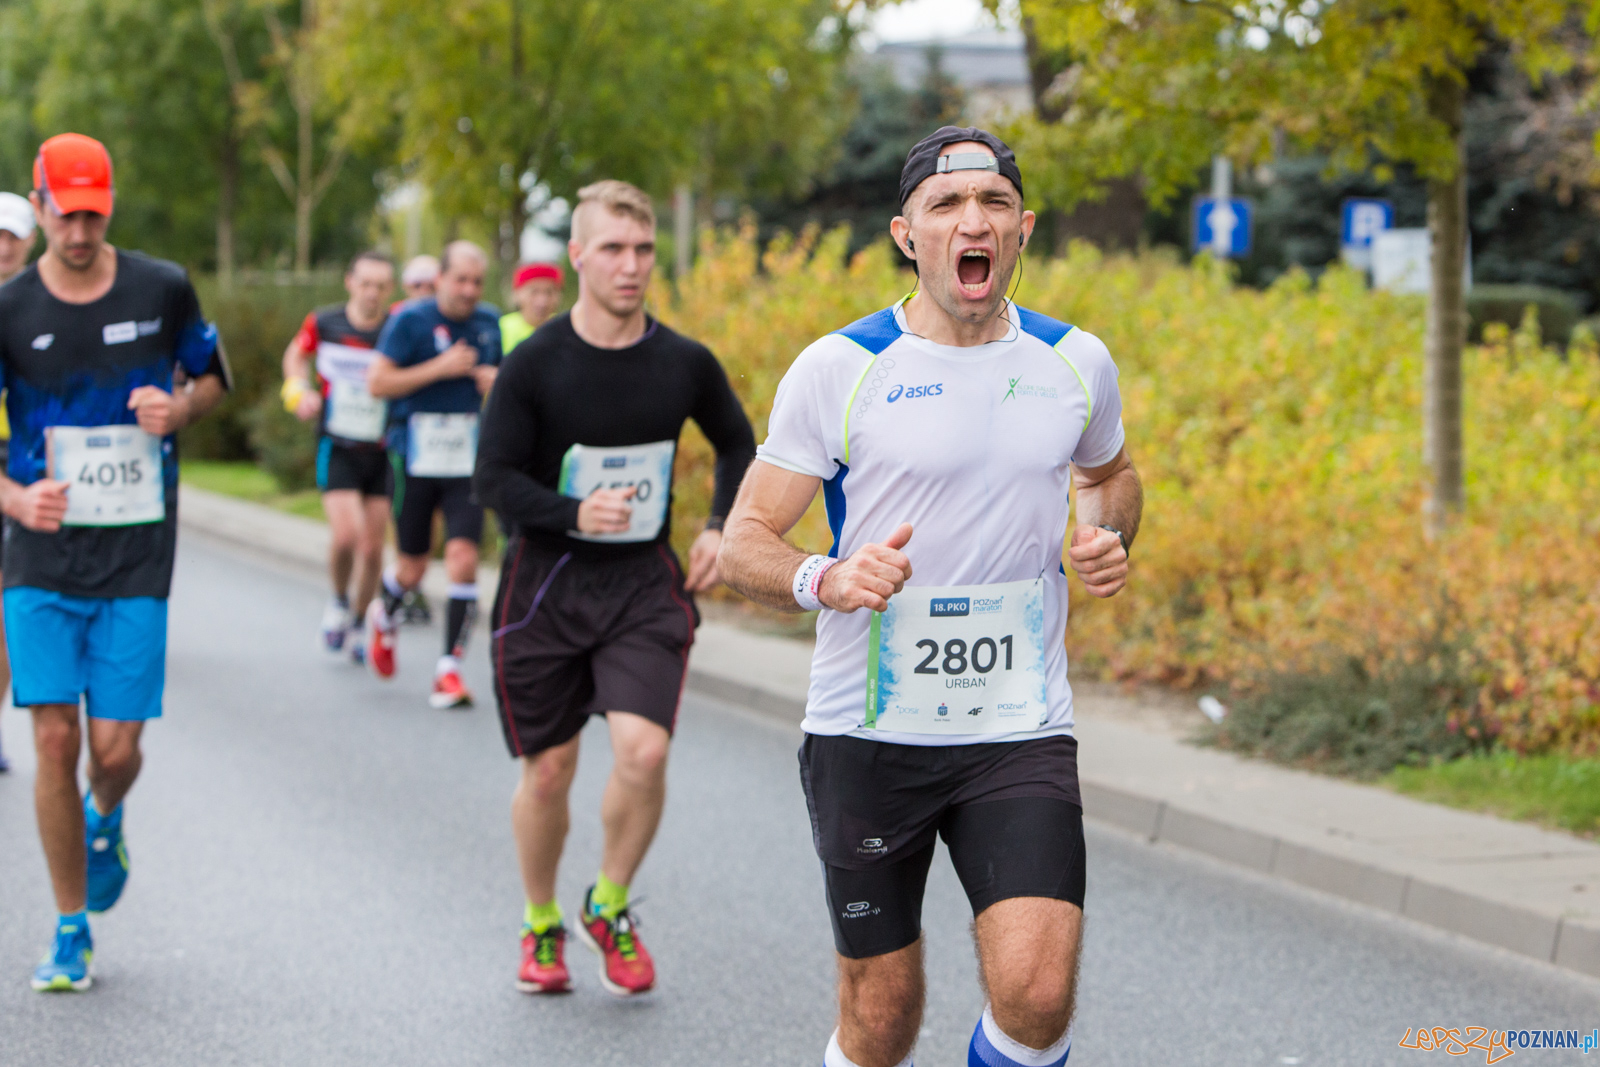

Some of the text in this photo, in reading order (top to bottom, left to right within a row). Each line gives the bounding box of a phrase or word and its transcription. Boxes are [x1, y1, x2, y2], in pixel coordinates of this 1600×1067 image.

[905, 383, 943, 398] asics
[78, 459, 143, 486] 4015
[933, 602, 968, 613] 18. PKO
[914, 634, 1013, 675] 2801
[945, 677, 987, 689] URBAN
[856, 846, 888, 854] Kalenji
[841, 907, 881, 919] Kalenji
